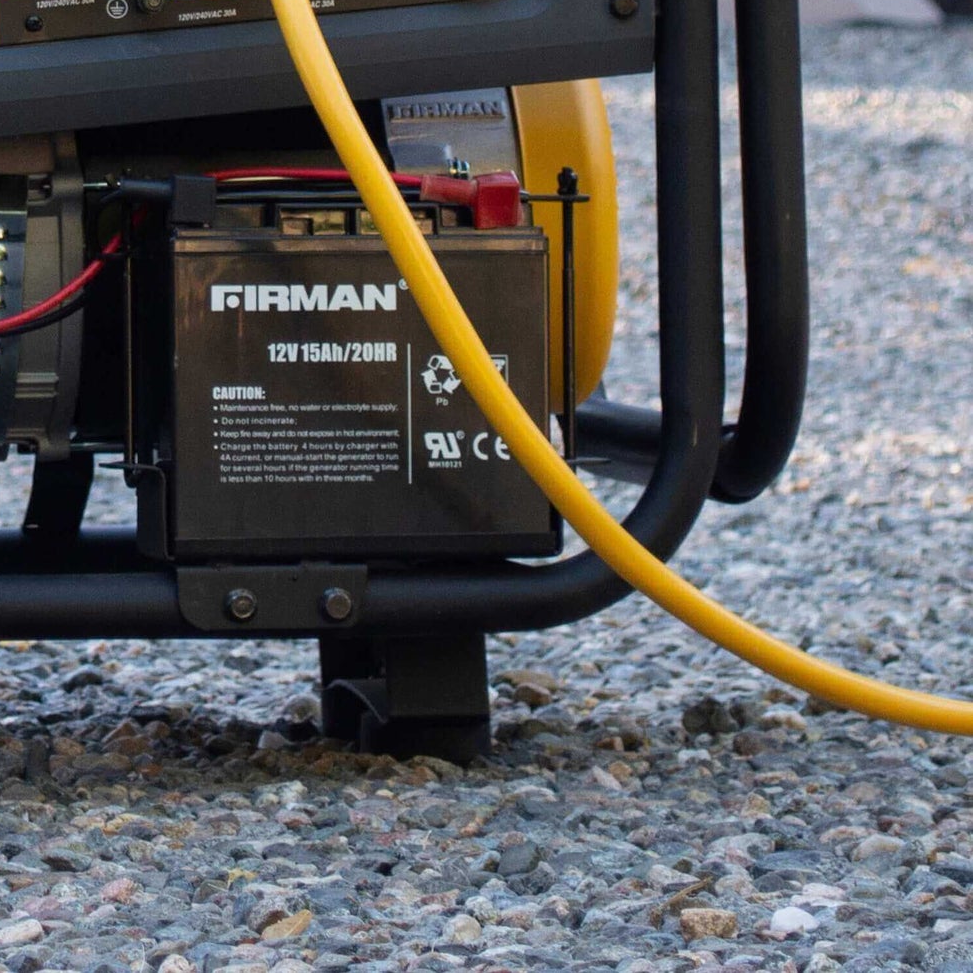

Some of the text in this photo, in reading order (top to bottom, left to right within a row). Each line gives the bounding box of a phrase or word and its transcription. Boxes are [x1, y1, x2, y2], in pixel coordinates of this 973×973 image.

[321, 0, 335, 7] 30A
[178, 9, 236, 21] 120V/240VAC 30A
[388, 101, 505, 121] FIRMAN
[210, 284, 397, 311] FIRMAN
[268, 342, 397, 362] 12V 15Ah/20HR
[213, 387, 266, 400] CAUTION:
[435, 398, 449, 406] Pb
[332, 404, 370, 412] electrolyte
[220, 443, 251, 452] Charge
[268, 442, 298, 451] battery
[334, 442, 346, 451] by
[346, 442, 379, 451] charger
[472, 432, 510, 460] CE
[338, 454, 376, 462] generator
[349, 464, 380, 472] running
